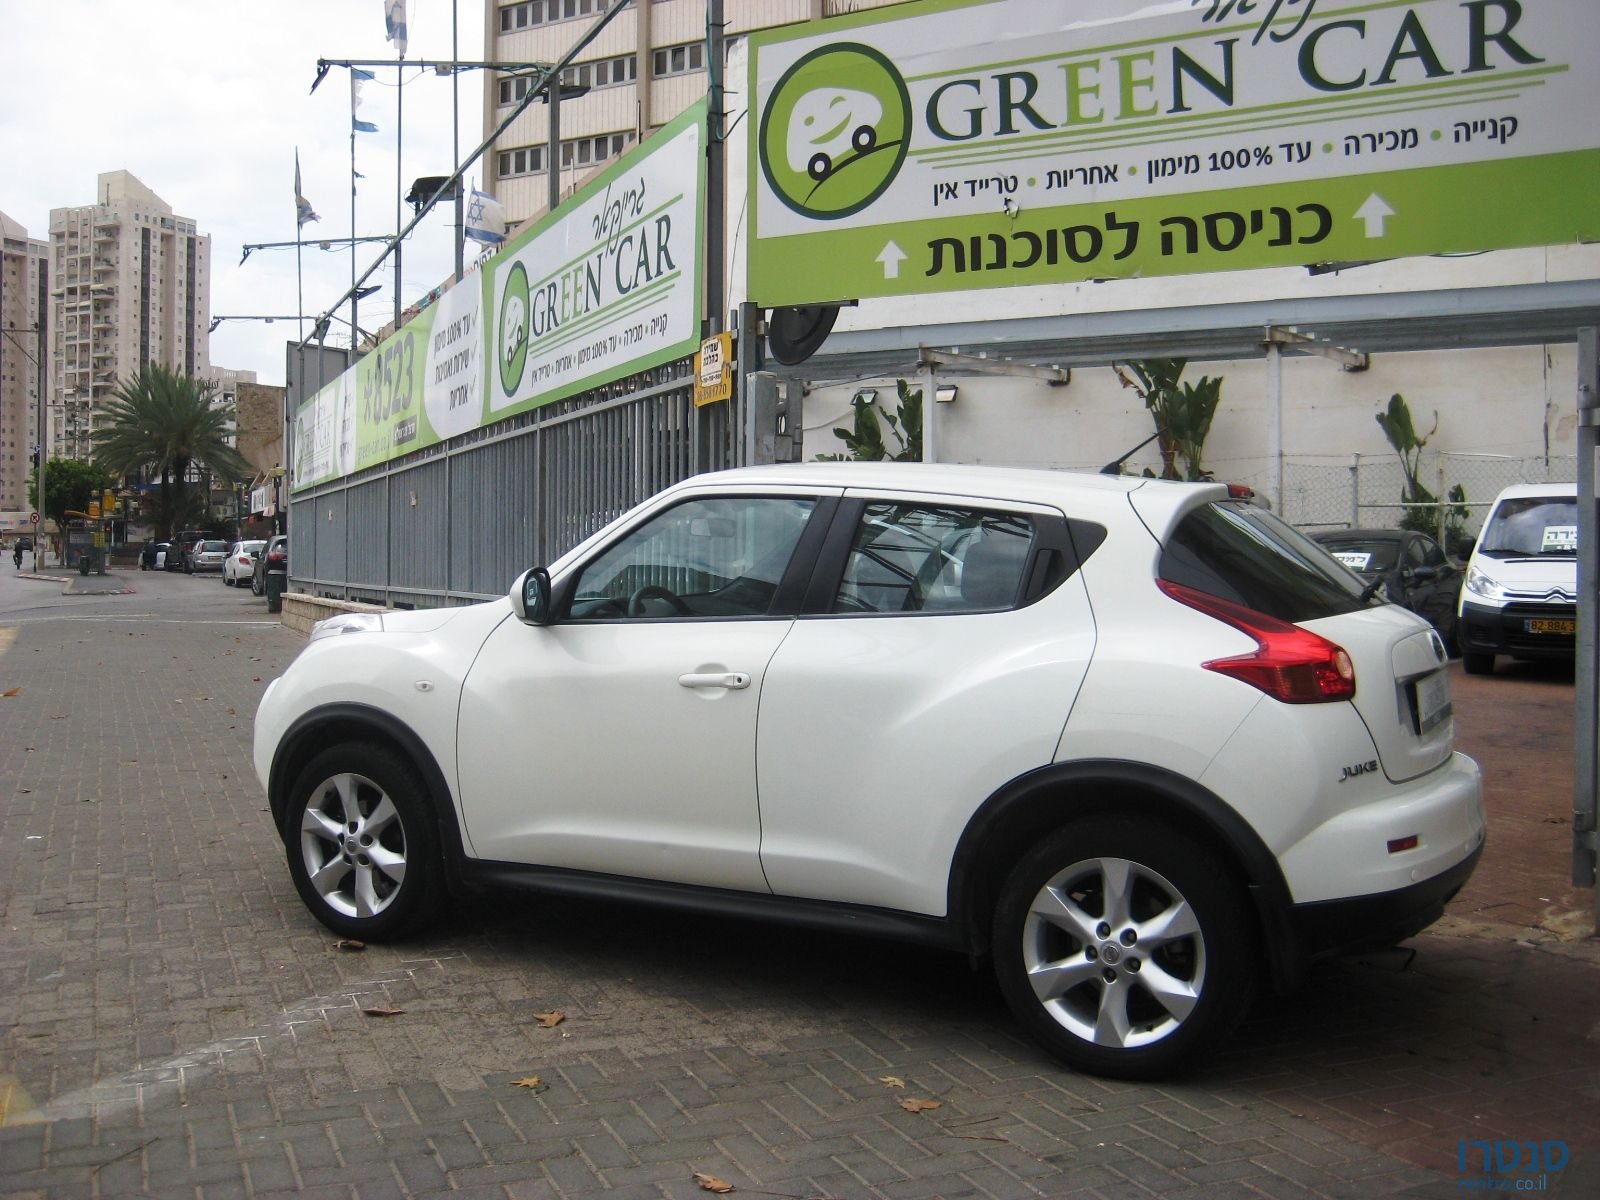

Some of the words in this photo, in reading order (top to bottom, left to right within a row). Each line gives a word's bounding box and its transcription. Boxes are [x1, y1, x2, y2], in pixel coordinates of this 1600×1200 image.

[925, 38, 1239, 141] GREEN
[1298, 0, 1546, 92] CAR
[1344, 128, 1418, 155] מכירה
[1453, 116, 1518, 144] קנייה
[1208, 146, 1273, 172] 100%
[1279, 141, 1311, 163] עד
[1046, 164, 1119, 190] אחריות
[1147, 154, 1200, 184] מימון
[933, 181, 958, 207] אין
[964, 175, 1018, 197] טרייד
[1160, 203, 1333, 256] כניסה
[925, 212, 1140, 277] לסוכנות
[532, 252, 603, 337] GREEN
[615, 214, 676, 294] CAR
[650, 314, 667, 336] קנייה
[592, 340, 608, 359] 100%
[1339, 760, 1378, 783] JUKE
